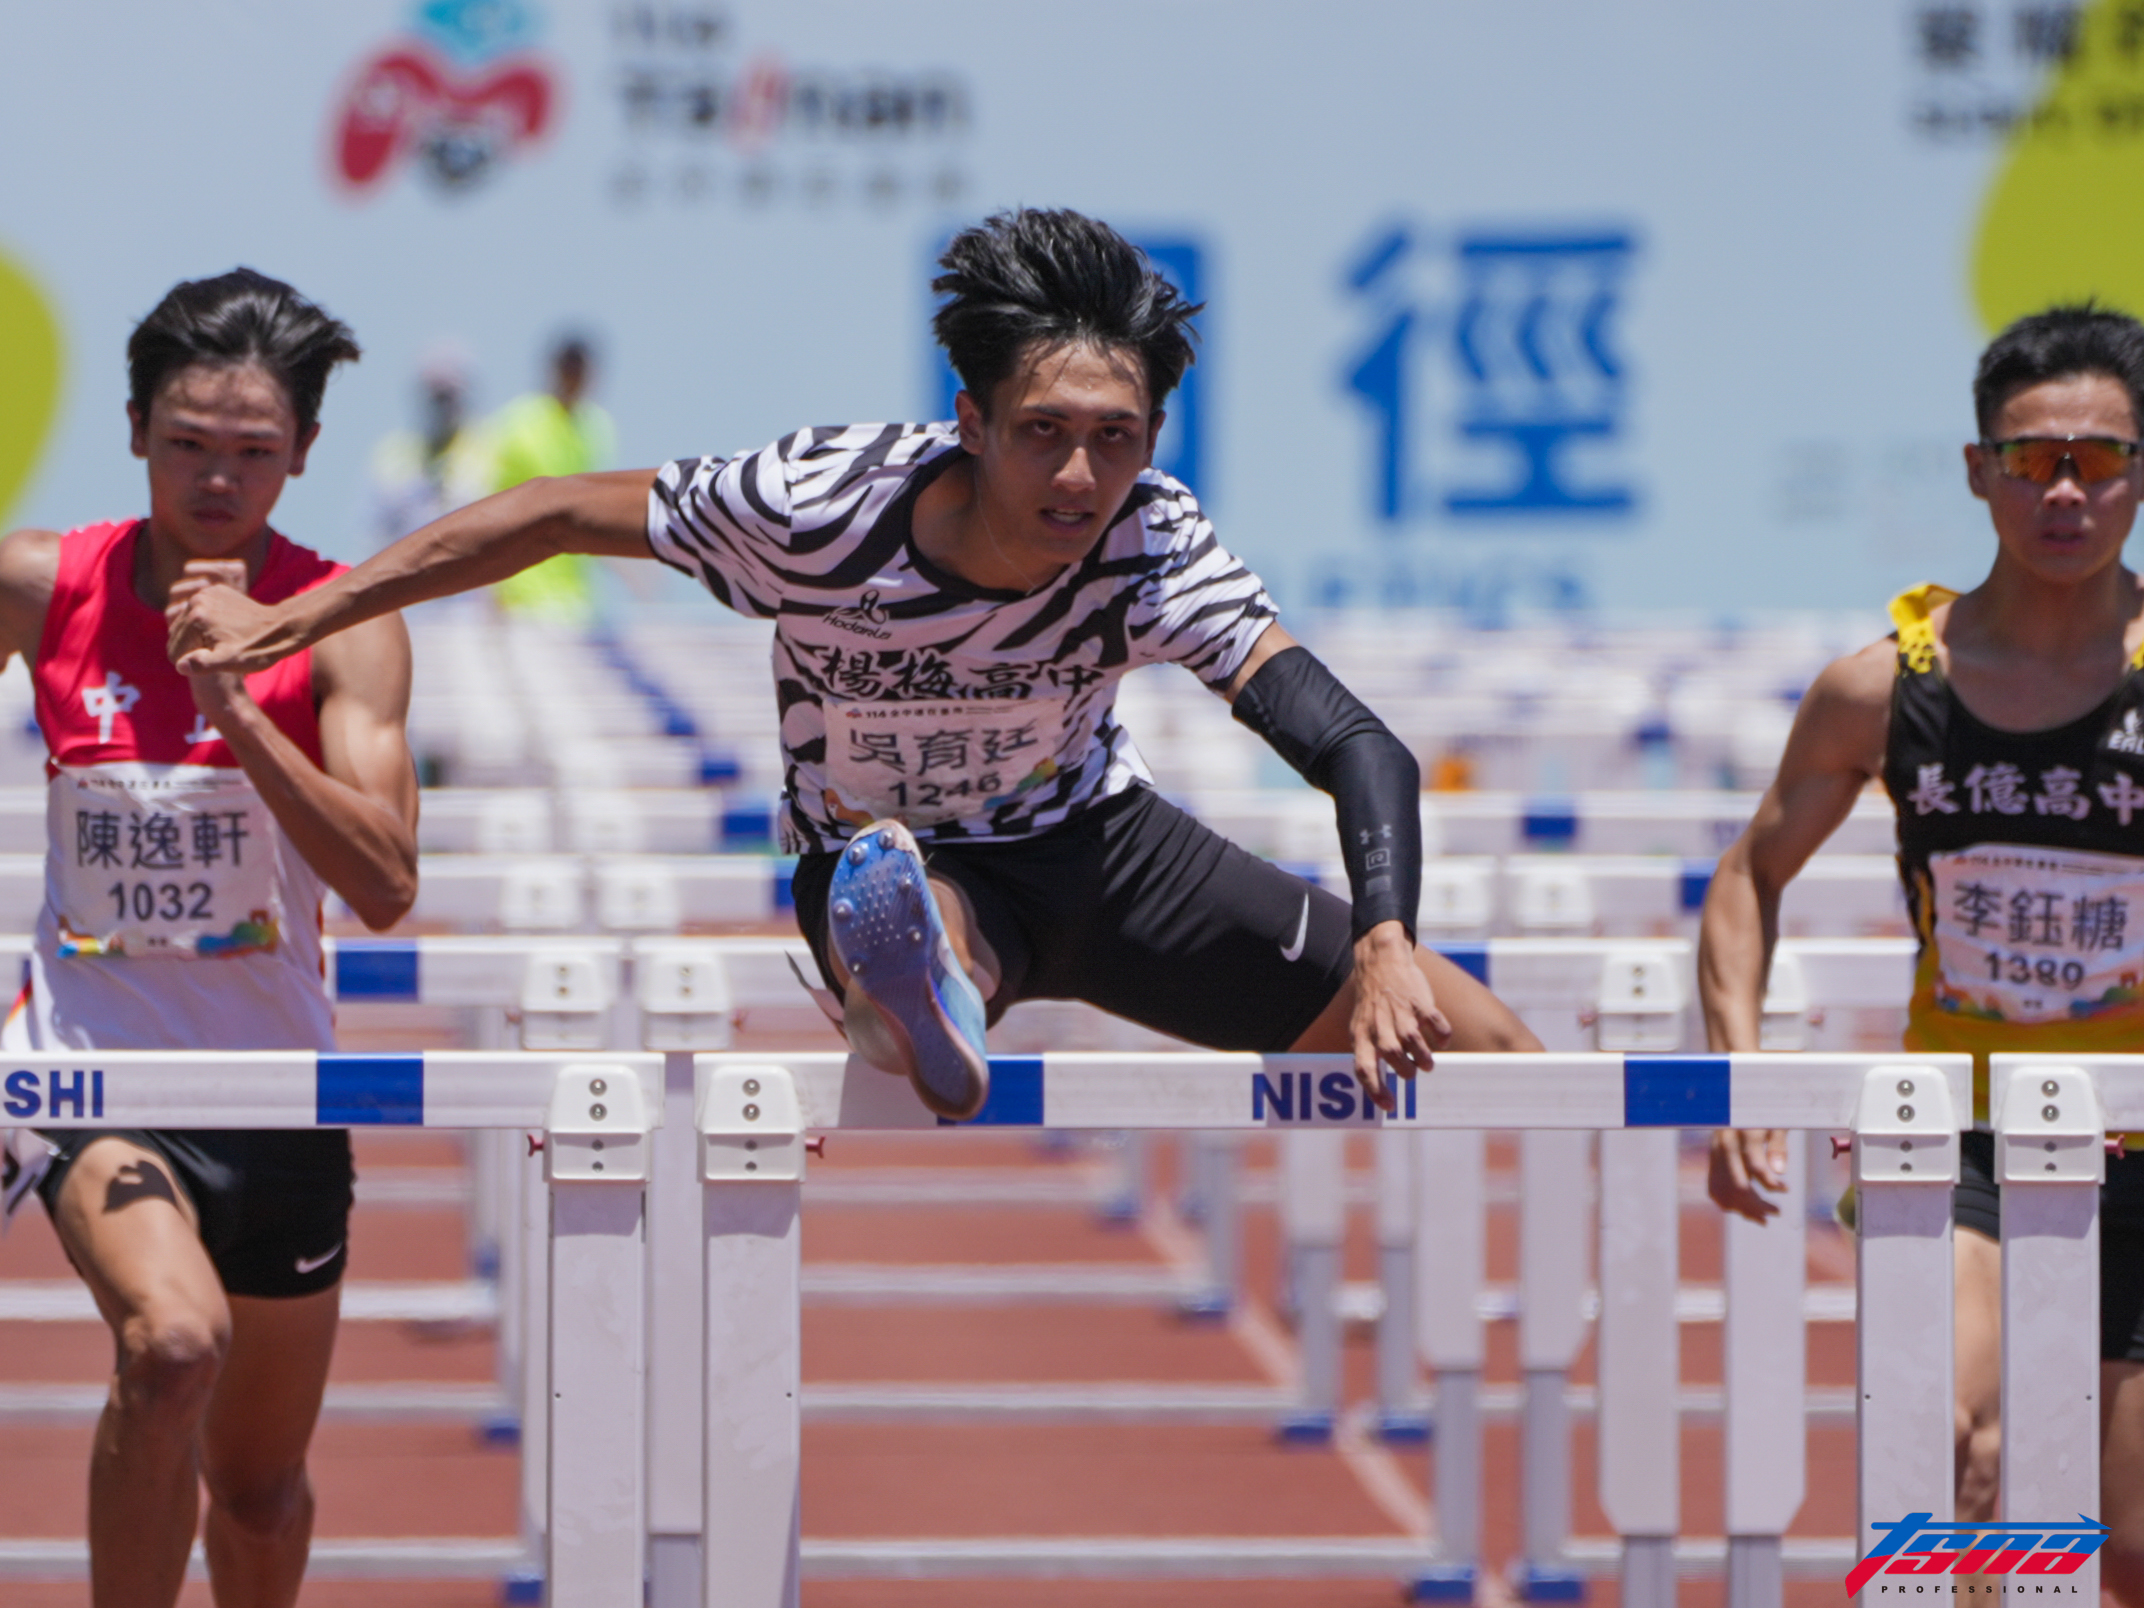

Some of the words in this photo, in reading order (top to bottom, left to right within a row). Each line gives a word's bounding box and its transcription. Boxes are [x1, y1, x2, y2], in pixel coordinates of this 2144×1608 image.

[820, 646, 1103, 697] 楊梅高中
[848, 724, 1040, 778] 吳育廷
[888, 772, 1001, 807] 1246
[1906, 761, 2144, 826] 長億高中
[75, 811, 249, 870] 陳逸軒
[107, 881, 214, 922] 1032
[1952, 882, 2129, 952] 李鈺糖
[4, 1070, 104, 1118] SHI
